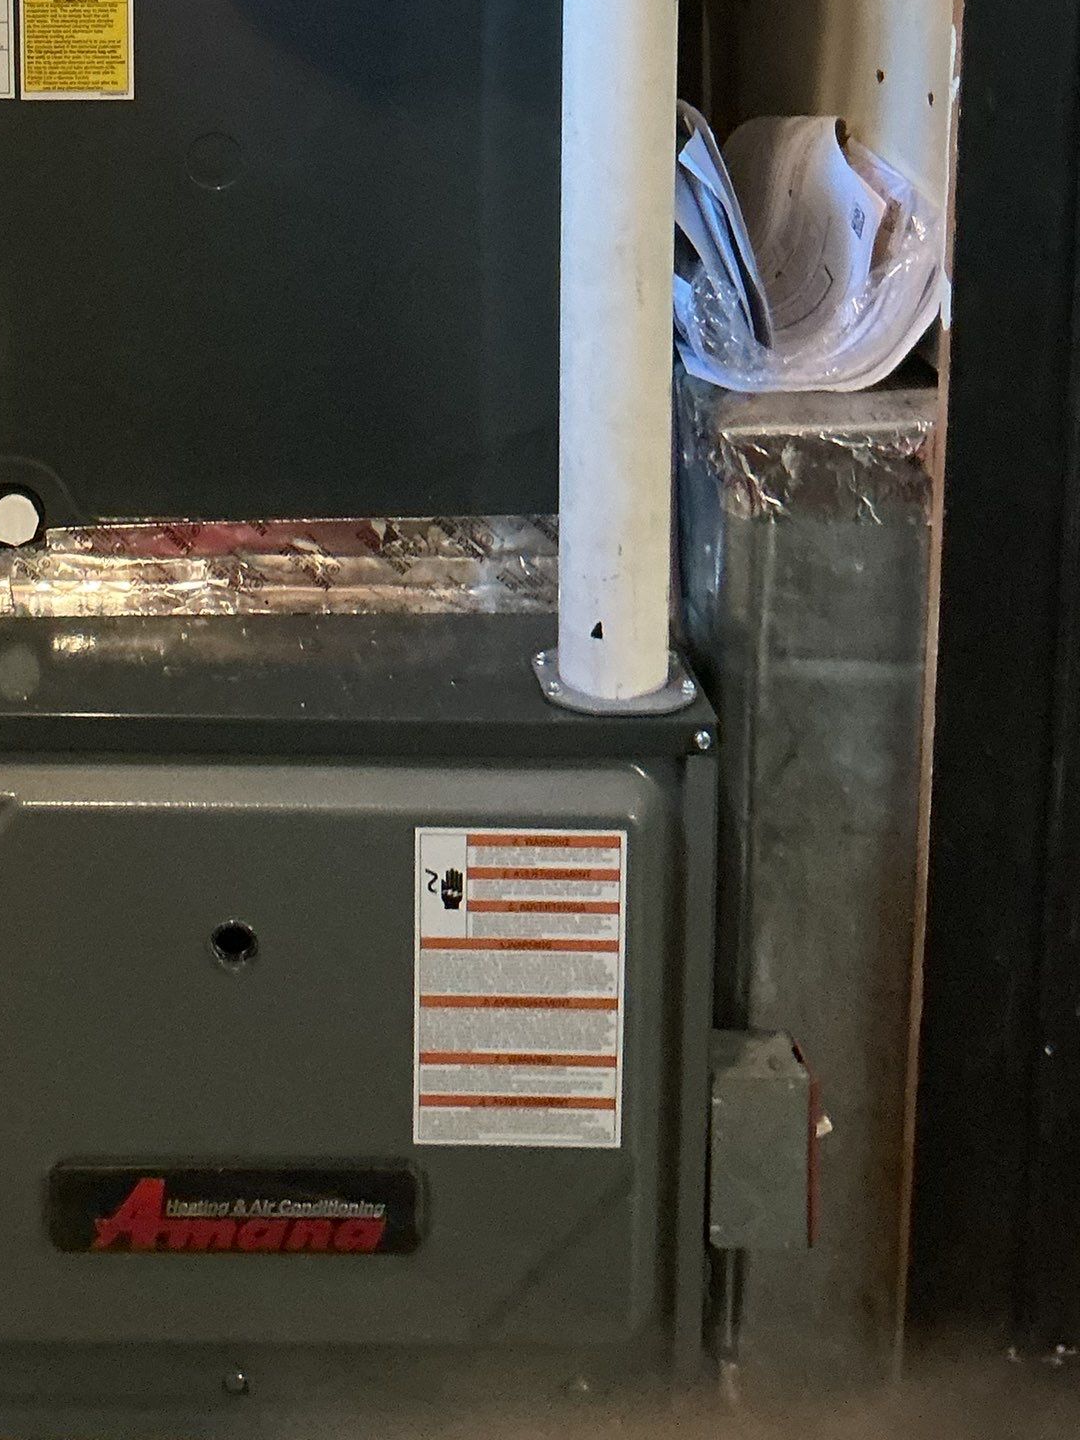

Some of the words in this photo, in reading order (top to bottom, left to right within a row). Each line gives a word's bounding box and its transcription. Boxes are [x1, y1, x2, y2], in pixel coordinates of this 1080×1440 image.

[91, 1177, 387, 1254] Amana
[167, 1199, 230, 1216] Heating
[233, 1199, 247, 1216] &
[250, 1200, 275, 1216] Air
[278, 1199, 386, 1218] Conditioning
